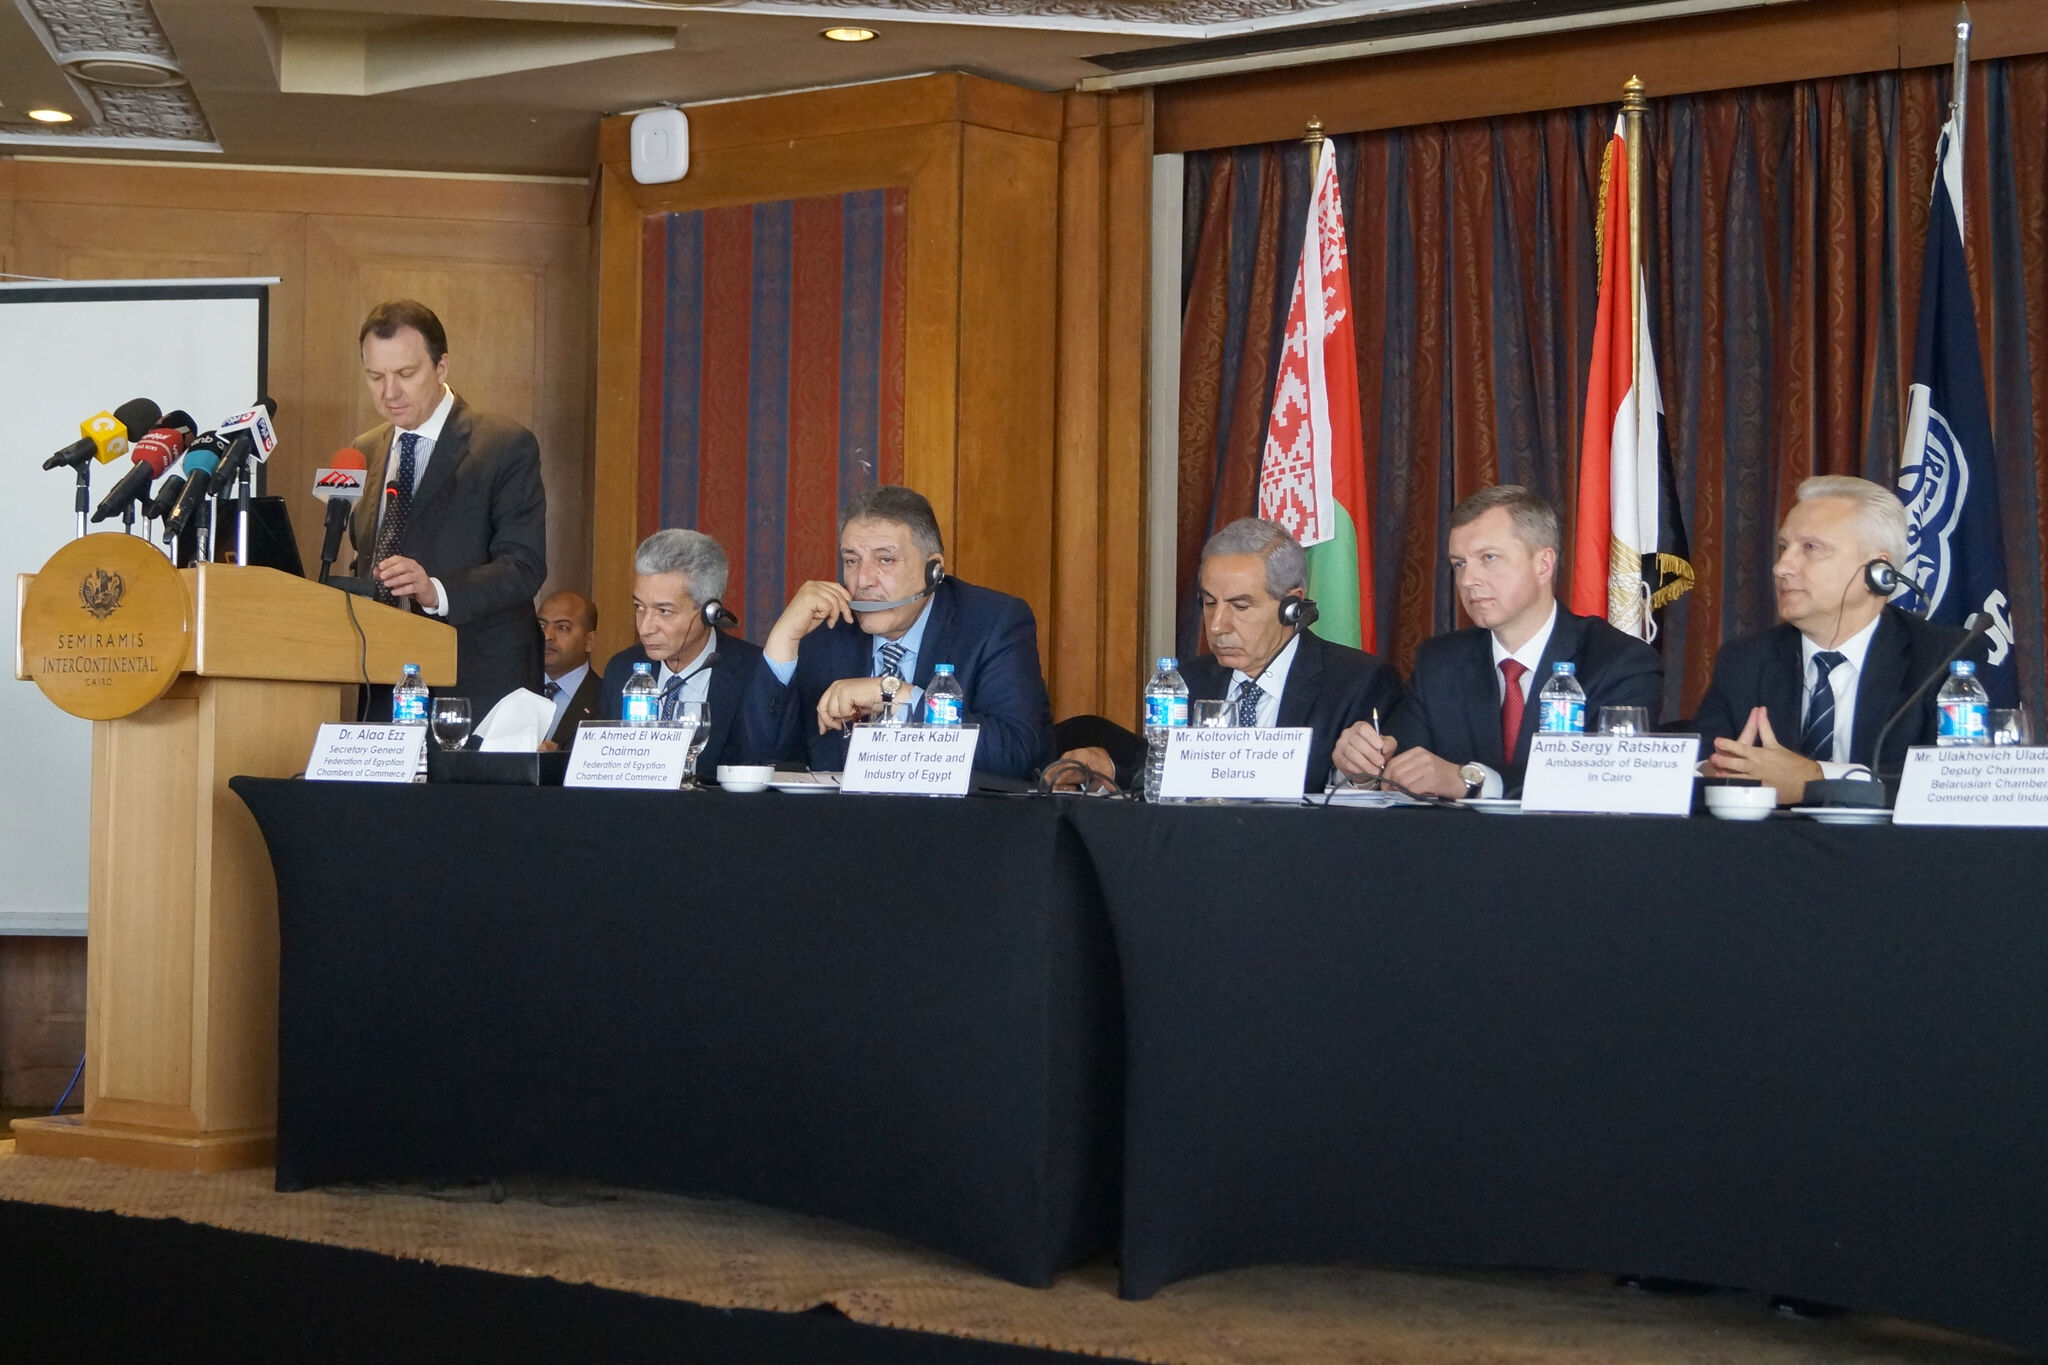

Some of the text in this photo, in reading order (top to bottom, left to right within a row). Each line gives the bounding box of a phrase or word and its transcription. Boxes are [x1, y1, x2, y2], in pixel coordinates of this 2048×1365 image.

[58, 632, 144, 649] SEMIRAMIS
[86, 678, 112, 686] CAIRO
[339, 728, 406, 741] Dr. Alaa Ezz
[582, 731, 682, 742] Mr. Ahmed El Wakill
[871, 731, 960, 743] Mr. Tarek Kabil
[1175, 730, 1304, 742] Mr. Koltovich Vladimir
[329, 745, 404, 755] Secretary General
[601, 745, 650, 757] Chairman
[1534, 740, 1688, 756] Amb.Sergy Ratshkof
[858, 752, 966, 763] Minister of Trade and
[1180, 748, 1295, 761] Minister of Trade of
[1914, 752, 1934, 762] Mr.
[1938, 751, 2011, 762] Ulakhovich
[323, 757, 405, 768] Federation of Egyptian
[582, 760, 666, 771] Federation of Egyptian
[1545, 758, 1678, 769] Ambassador of Belarus
[316, 767, 406, 778] Chambers of Commerce
[575, 771, 668, 782] Chambers of Commerce
[864, 769, 952, 783] Industry of Egypt
[1211, 768, 1256, 779] Belarus
[1940, 765, 2045, 777] Deputy Chairman
[1601, 772, 1633, 783] Cairo
[1930, 779, 1992, 789] Belarusian
[1927, 793, 1990, 803] Commerce
[1992, 793, 2014, 802] and
